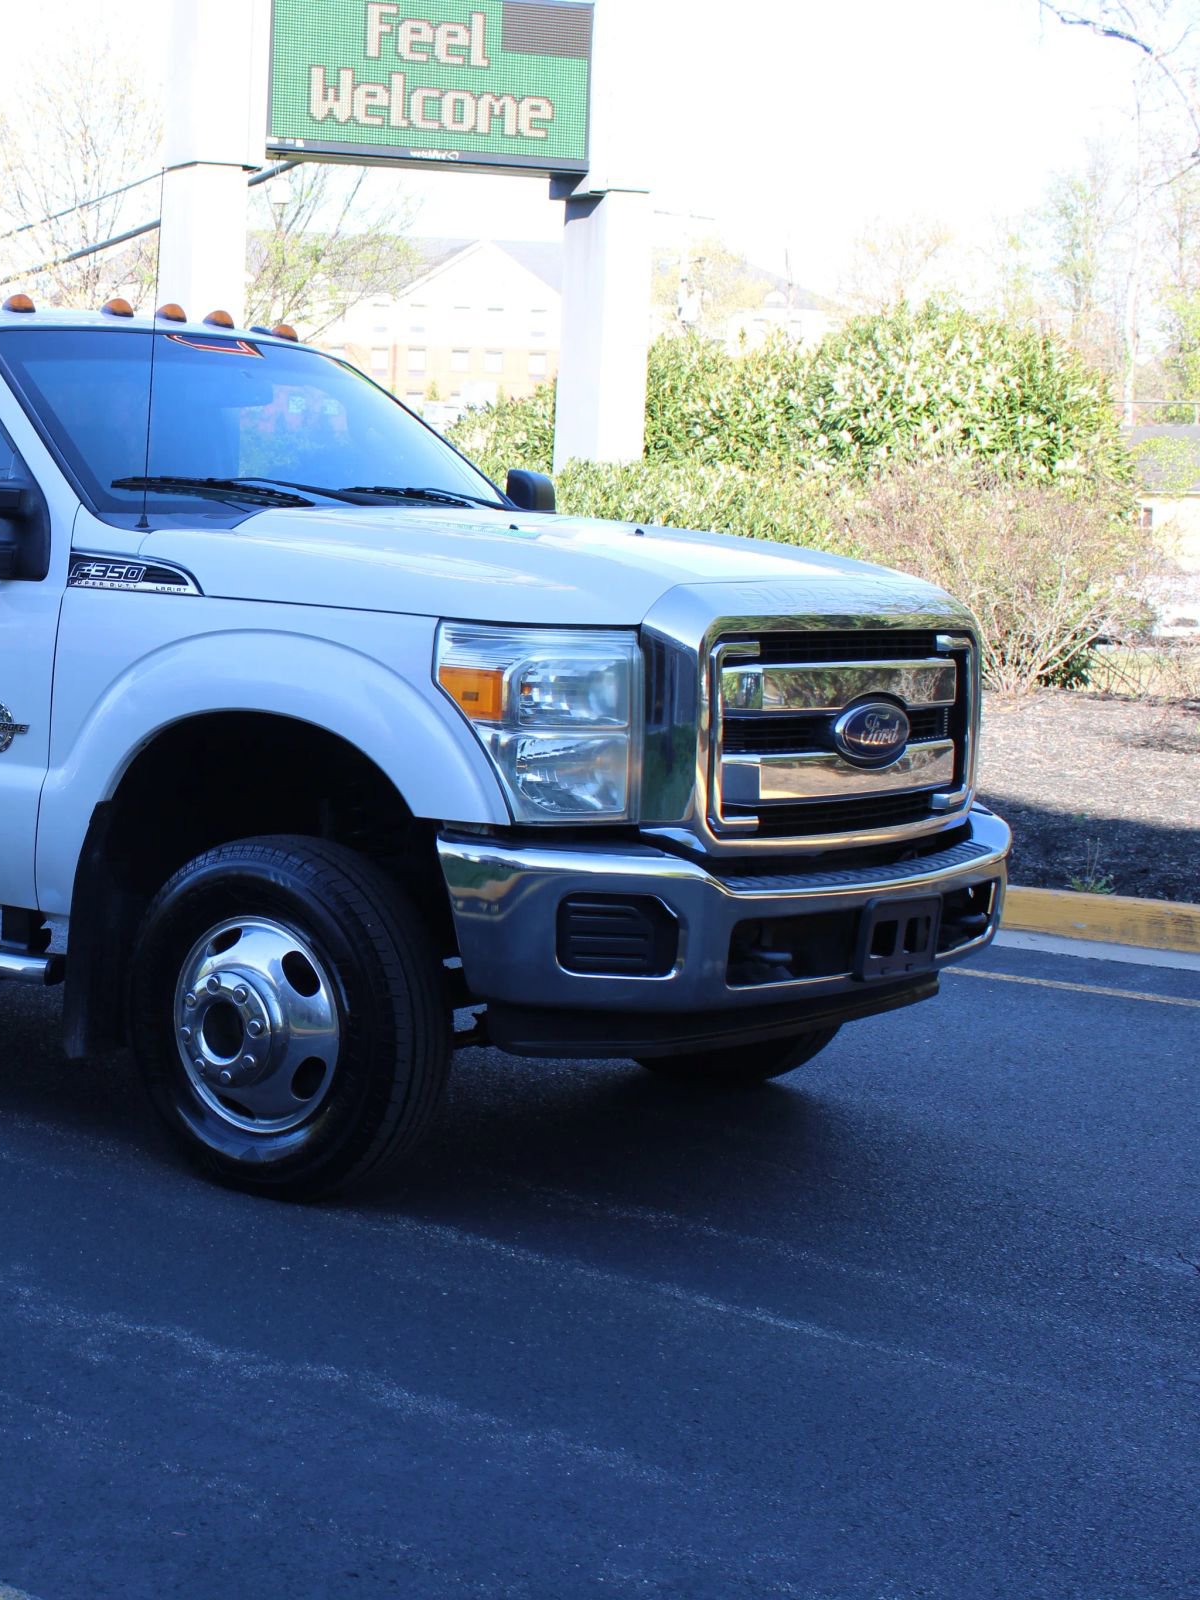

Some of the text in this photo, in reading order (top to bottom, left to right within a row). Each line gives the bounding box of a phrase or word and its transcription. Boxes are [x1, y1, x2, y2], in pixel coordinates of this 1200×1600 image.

[366, 2, 490, 67] Feel
[309, 65, 553, 138] Welcome
[860, 713, 900, 744] Ford
